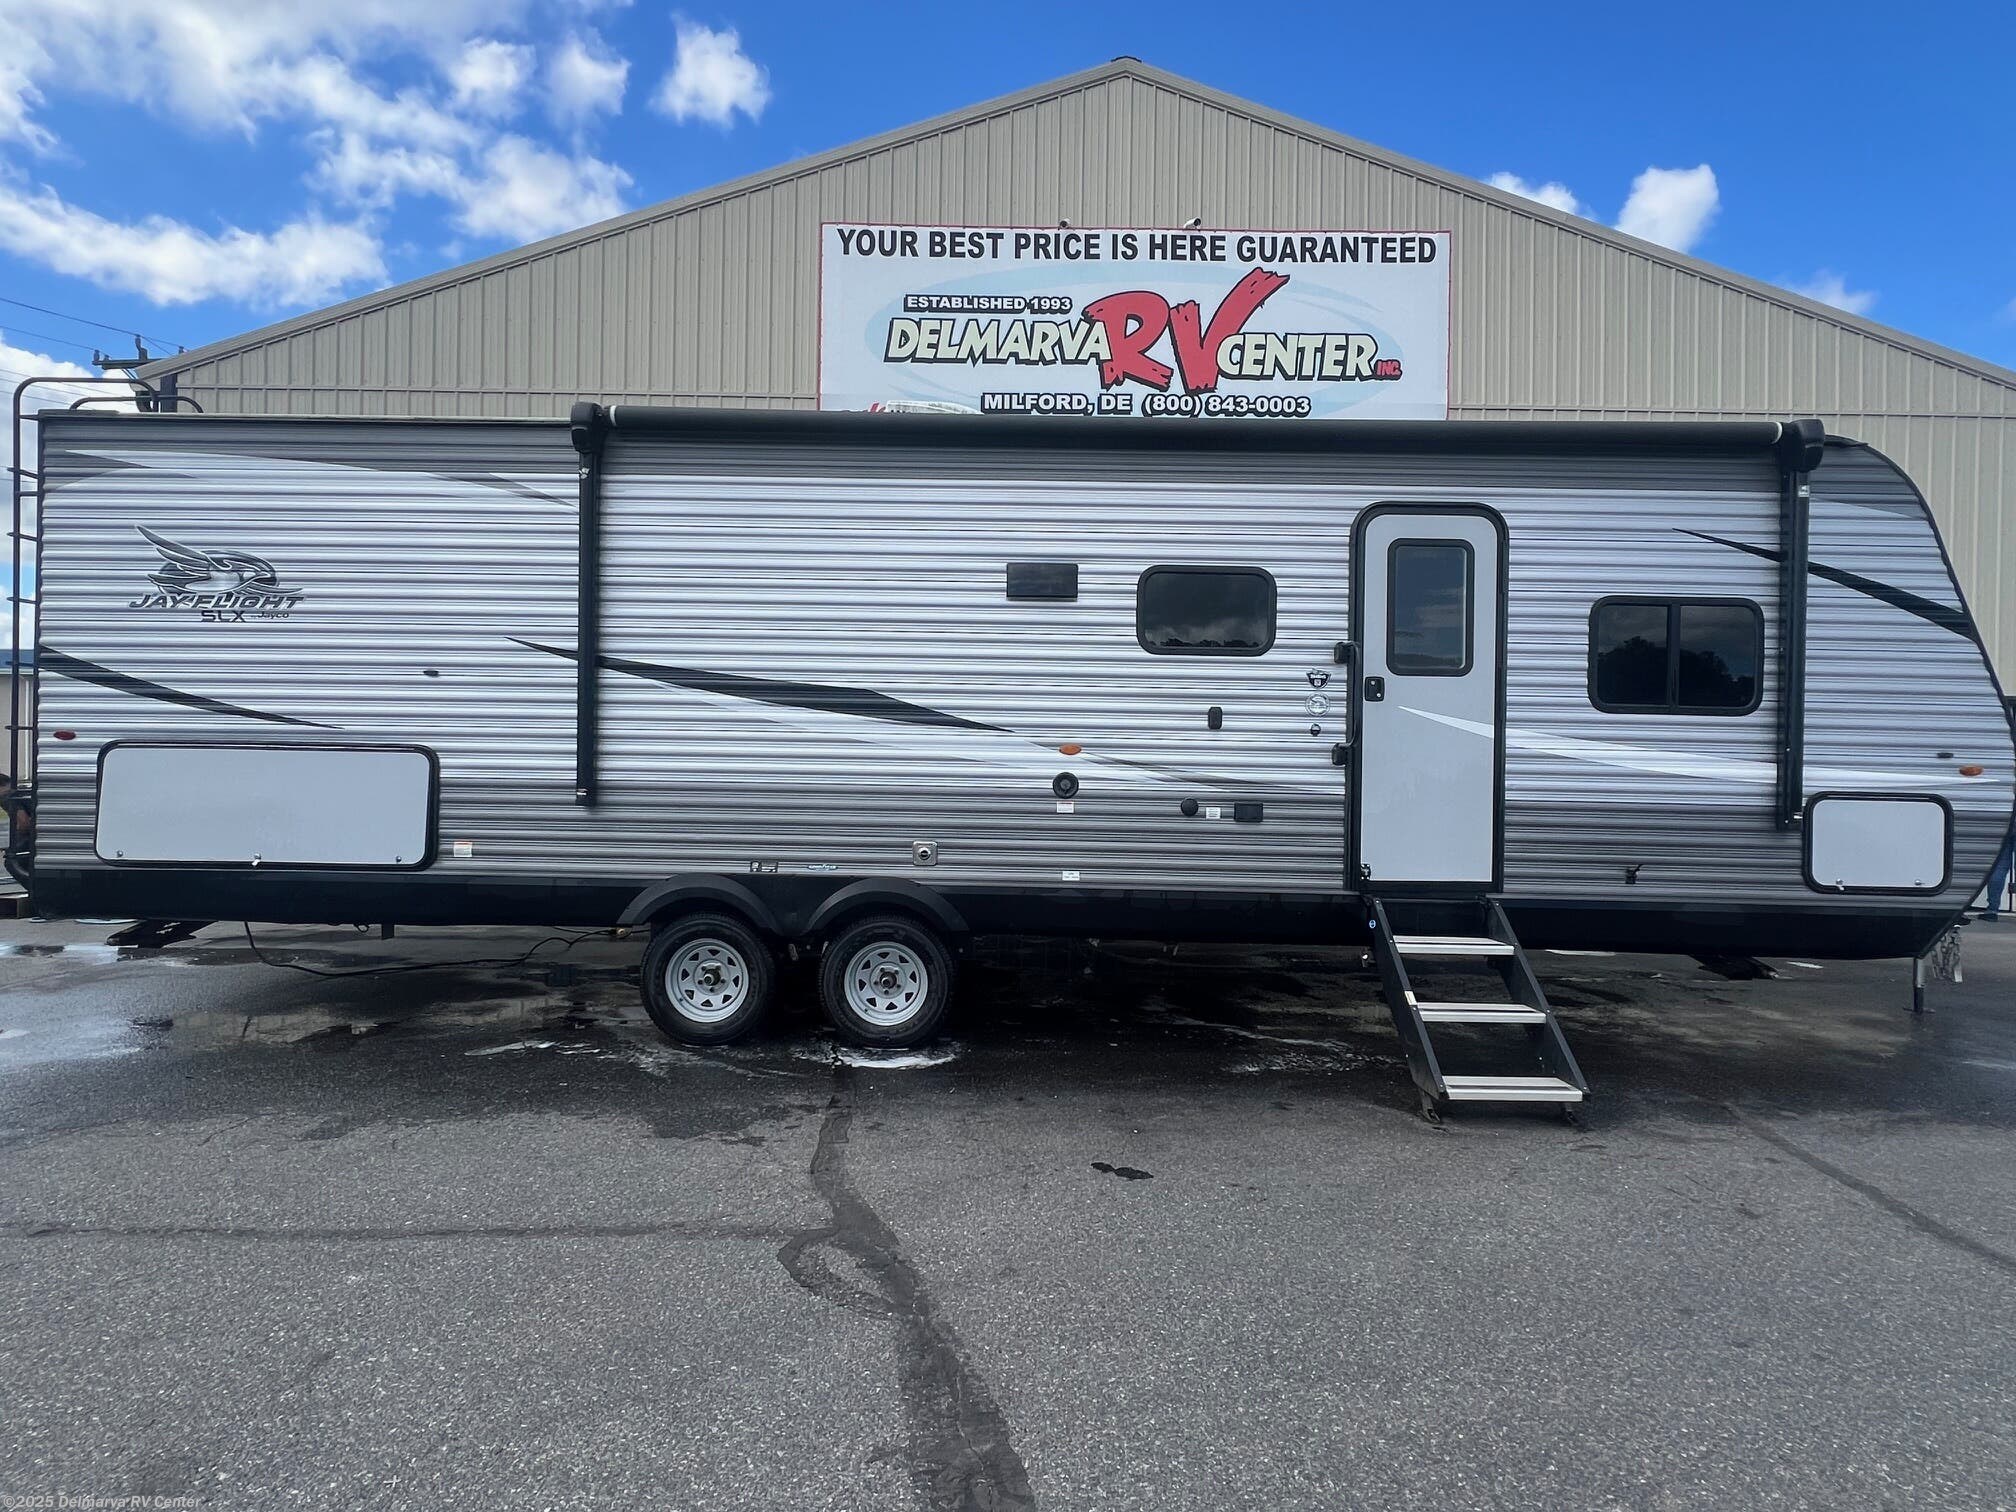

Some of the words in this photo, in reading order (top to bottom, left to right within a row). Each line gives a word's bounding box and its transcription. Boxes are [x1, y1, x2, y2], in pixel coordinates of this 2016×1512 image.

[837, 228, 919, 258] YOUR
[929, 231, 1004, 259] BEST
[1014, 233, 1101, 260] PRICE
[1111, 233, 1139, 260] IS
[1149, 234, 1227, 262] HERE
[1236, 236, 1437, 264] GUARANTEED
[905, 295, 1027, 313] ESTABLISHED
[1030, 297, 1073, 313] 1993
[885, 318, 1112, 364] DELMARVA
[1082, 267, 1290, 392] RV
[1216, 332, 1378, 381] CENTER
[983, 393, 1095, 414] MILFORD,
[1099, 394, 1133, 411] DE
[1143, 395, 1202, 415] (800)
[1207, 396, 1312, 416] 843-0003
[129, 594, 192, 609] JAY
[191, 594, 305, 609] FLIGHT
[200, 610, 246, 622] SLX
[257, 611, 289, 619] Jayco
